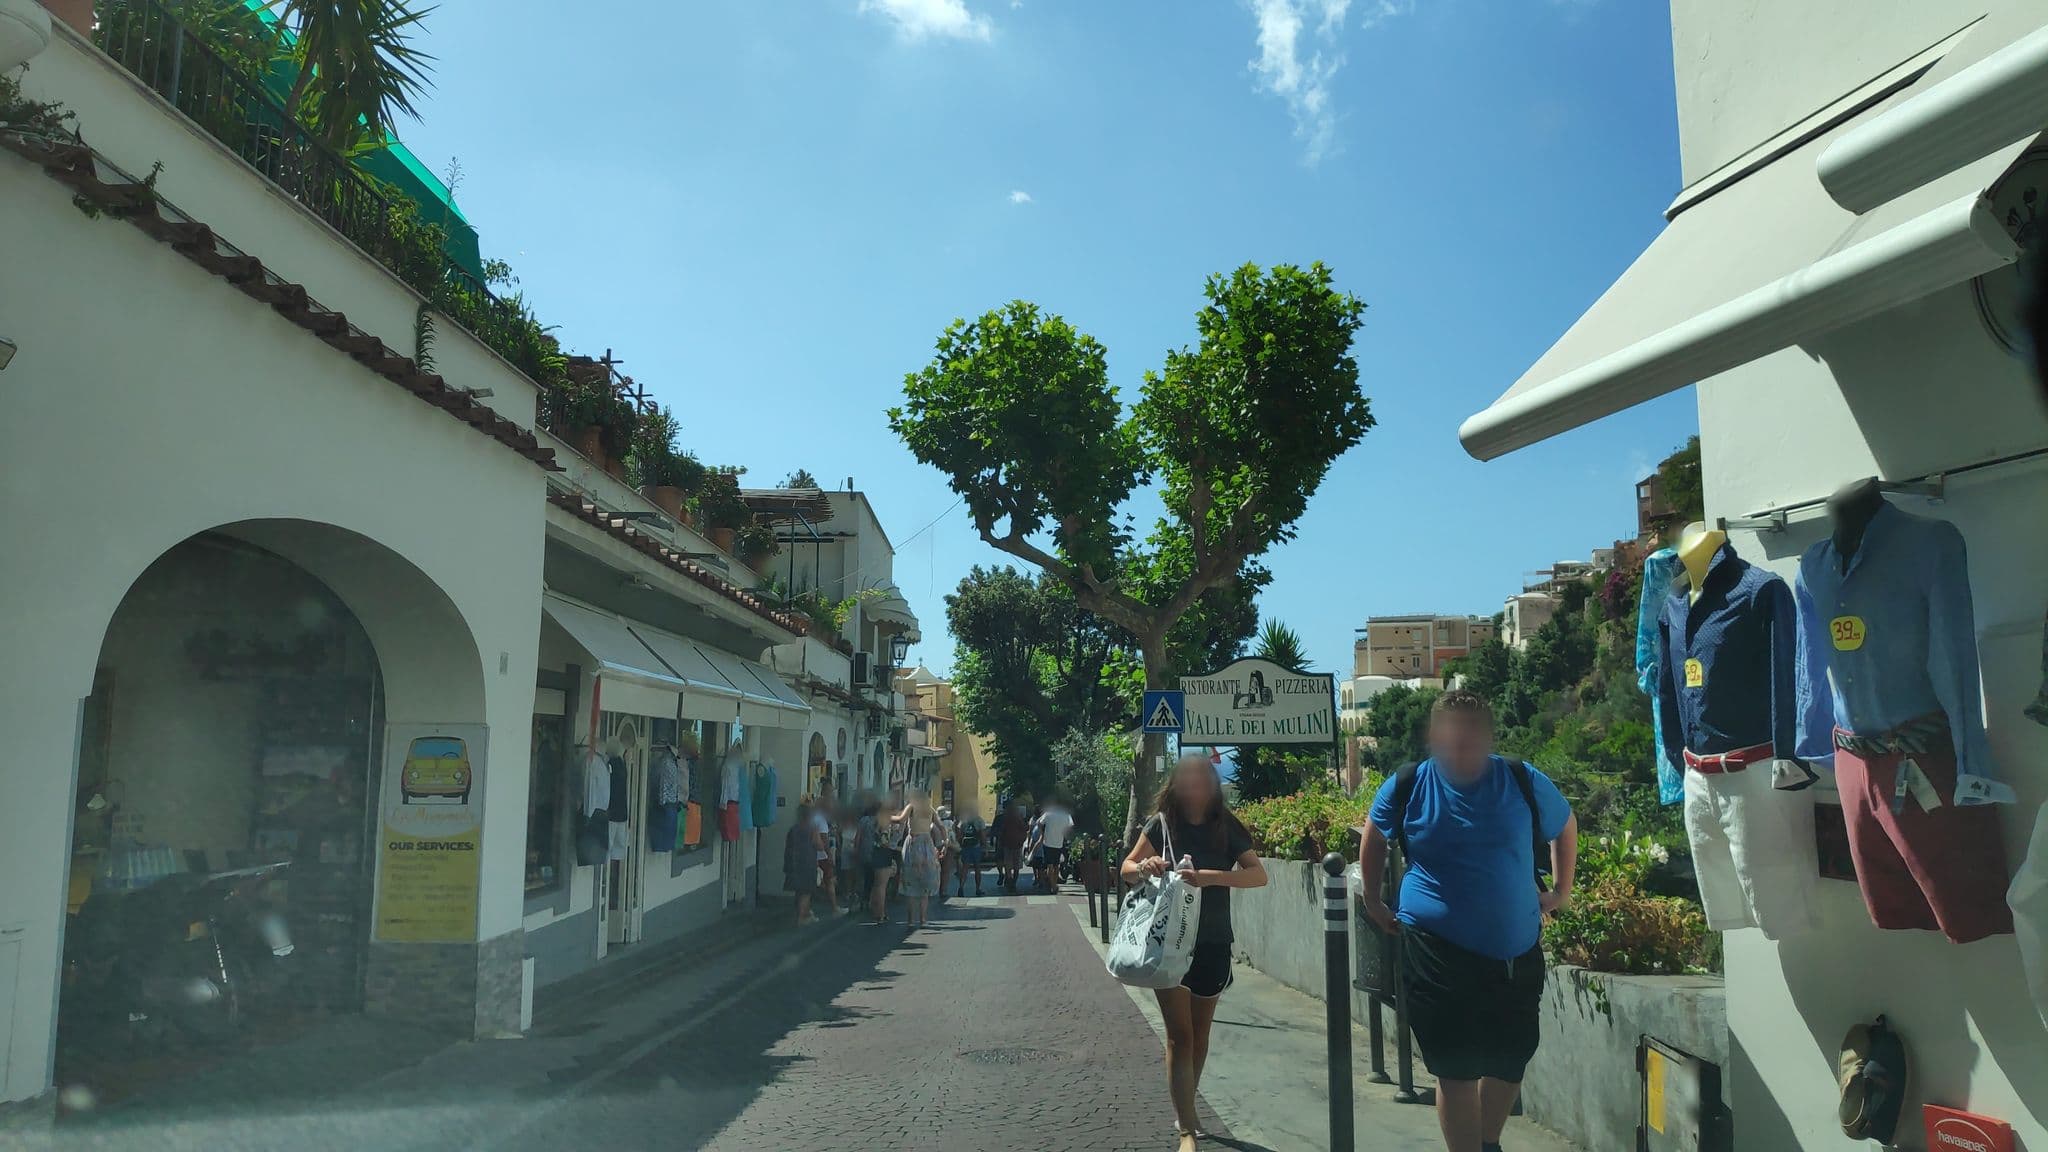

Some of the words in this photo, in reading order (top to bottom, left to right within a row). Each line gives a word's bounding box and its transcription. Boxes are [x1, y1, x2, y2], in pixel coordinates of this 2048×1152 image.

[1181, 679, 1241, 695] RISTORANTE
[1275, 679, 1329, 694] PIZZERIA
[1185, 709, 1235, 735] VALLE
[1241, 719, 1265, 735] DEI
[1273, 709, 1329, 735] MULINI
[389, 841, 415, 851] OUR
[416, 841, 474, 851] SERVICES:
